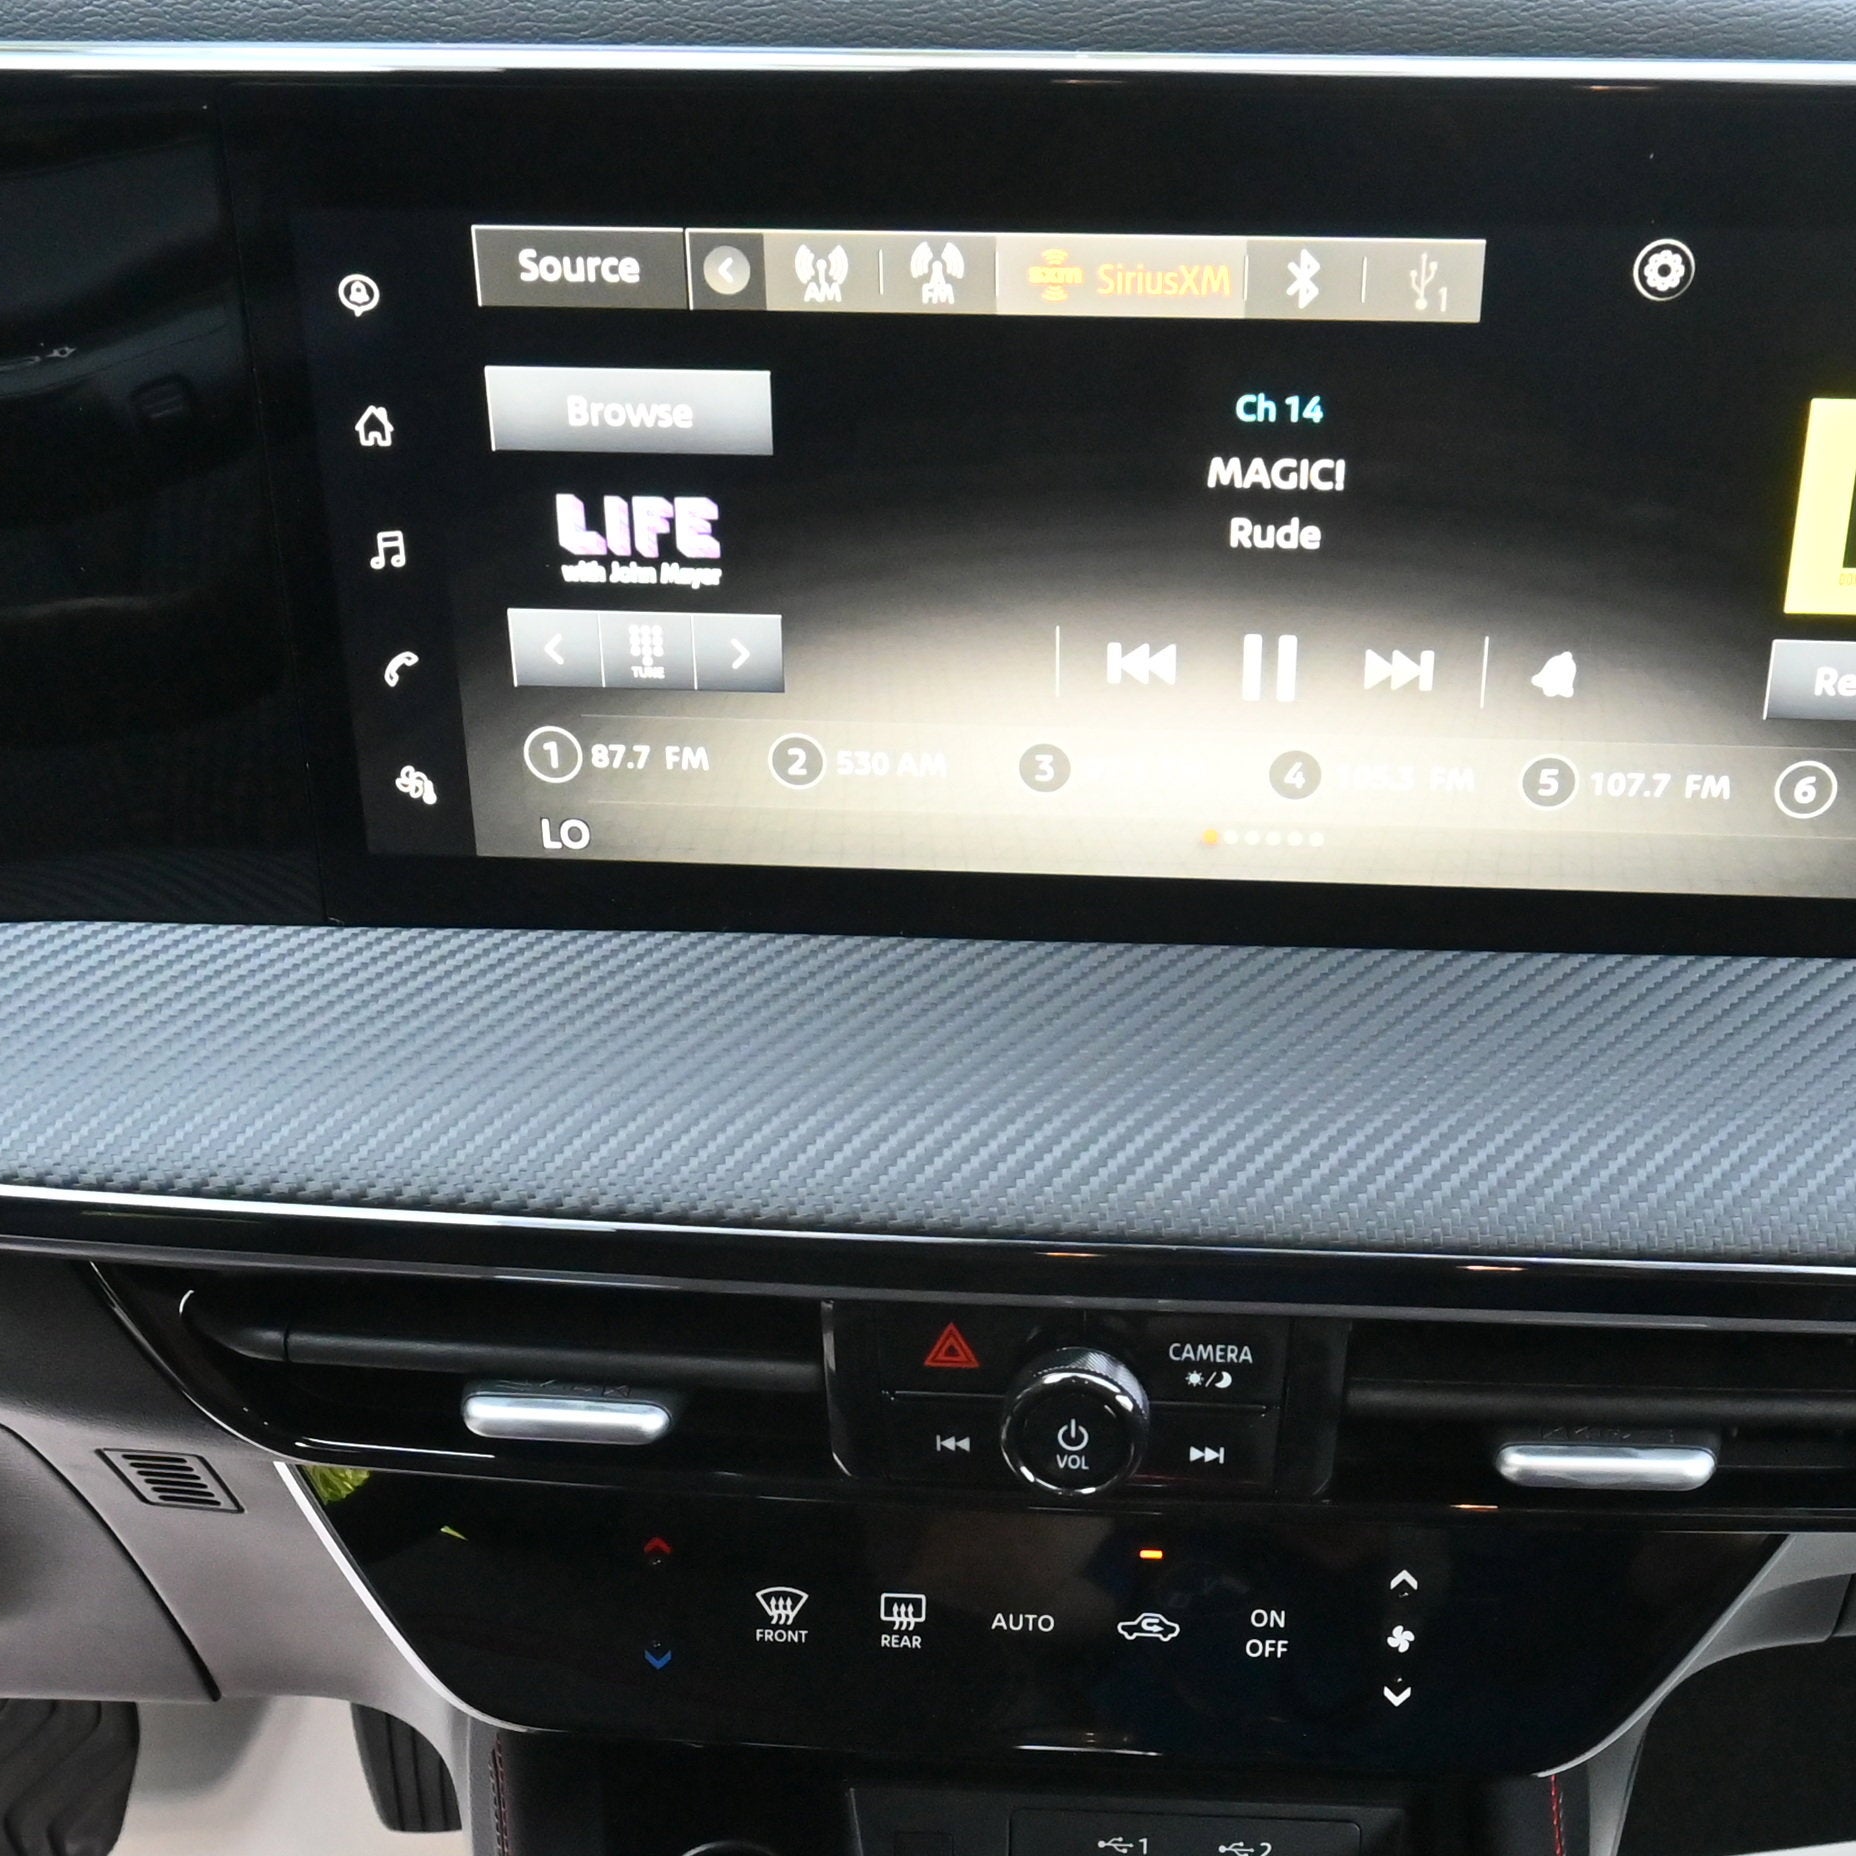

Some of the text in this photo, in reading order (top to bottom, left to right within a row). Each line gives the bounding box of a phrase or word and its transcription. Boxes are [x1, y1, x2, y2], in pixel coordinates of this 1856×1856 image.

[518, 249, 640, 285] Source
[1096, 263, 1232, 297] SiriusXM
[804, 281, 842, 302] AM
[567, 395, 694, 430] Browse
[1236, 393, 1324, 423] Ch 14
[1206, 456, 1346, 492] MAGIC!
[556, 493, 721, 558] LIFE
[1229, 516, 1322, 550] Rude
[543, 740, 709, 771] 1 87.7 FM
[786, 747, 890, 776] 2 530
[1034, 754, 1055, 782] 3
[1283, 761, 1306, 788] 4
[1538, 768, 1730, 800] 5 107.7 FM
[1793, 776, 1817, 804] 6
[541, 819, 591, 851] LO
[1168, 1342, 1253, 1365] CAMERA
[1056, 1453, 1090, 1472] VOL
[991, 1613, 1055, 1633] AUTO
[1250, 1608, 1286, 1629] ON
[755, 1629, 809, 1644] FRONT
[881, 1634, 922, 1649] REAR
[1246, 1638, 1289, 1659] OFF
[1138, 1837, 1148, 1855] 1
